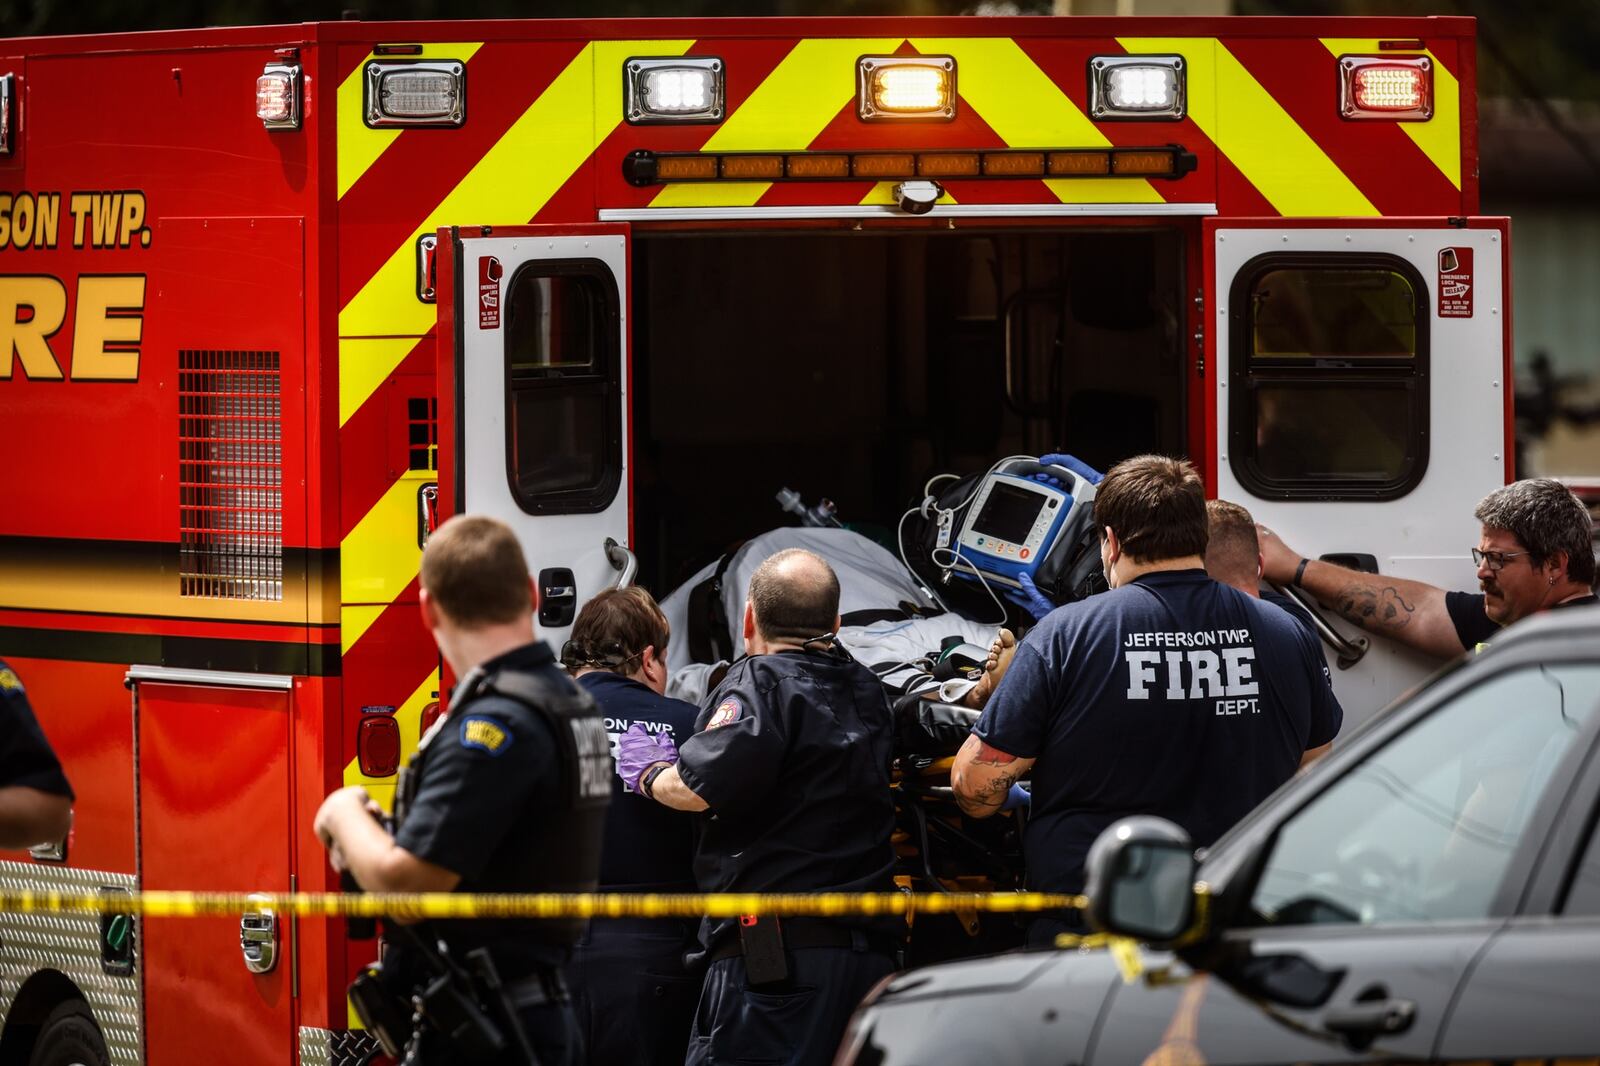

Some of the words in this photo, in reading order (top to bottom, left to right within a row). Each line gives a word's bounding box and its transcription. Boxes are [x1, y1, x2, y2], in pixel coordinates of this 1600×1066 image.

[70, 190, 152, 250] TWP.
[1445, 285, 1466, 294] RELEASE
[1124, 631, 1216, 647] JEFFERSON
[1217, 629, 1252, 645] TWP.
[1125, 647, 1259, 700] FIRE
[1215, 698, 1261, 716] DEPT.
